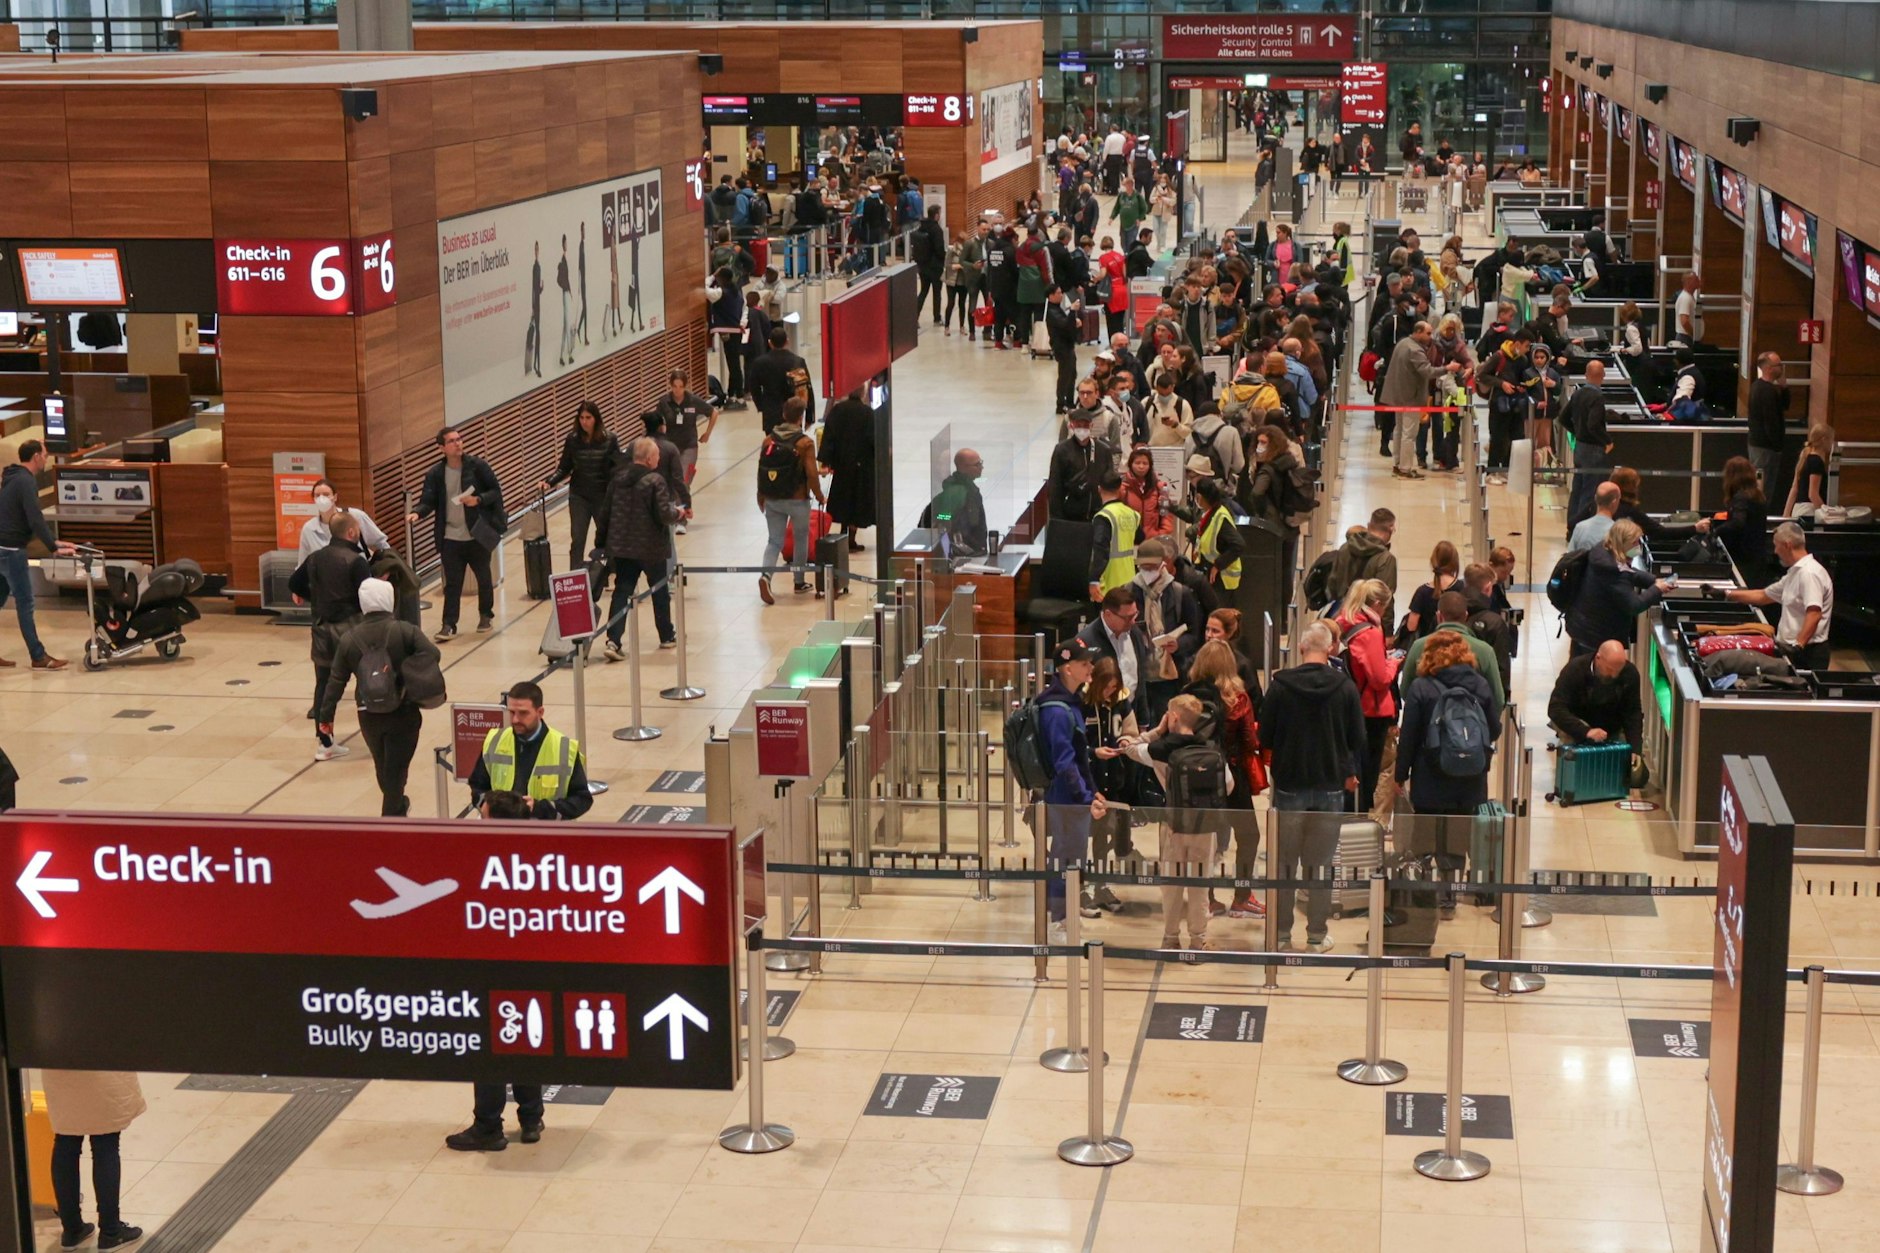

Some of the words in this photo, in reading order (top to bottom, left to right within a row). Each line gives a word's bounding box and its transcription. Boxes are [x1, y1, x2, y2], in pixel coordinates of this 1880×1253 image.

[1286, 25, 1293, 36] 5
[1222, 38, 1257, 49] Security
[1261, 38, 1293, 47] Control
[1217, 49, 1233, 57] Alle
[1235, 49, 1256, 57] Gates
[1260, 49, 1270, 57] All
[1271, 49, 1293, 57] Gates
[908, 96, 937, 104] Check-in
[943, 96, 961, 121] 8
[694, 162, 702, 200] 6
[442, 231, 471, 254] Business
[471, 231, 479, 247] as
[480, 221, 497, 244] usual
[226, 245, 291, 261] Check-in
[380, 239, 394, 293] 6
[443, 265, 455, 285] Der
[456, 259, 470, 281] BER
[471, 257, 480, 276] im
[480, 247, 510, 273] Überblick
[310, 246, 346, 300] 6
[564, 584, 585, 592] Runway
[469, 712, 484, 720] BER
[772, 709, 787, 717] BER
[469, 720, 500, 728] Runway
[772, 717, 804, 726] Runway
[93, 844, 272, 884] Check-in
[480, 853, 624, 903] Abflug
[965, 871, 981, 879] BER
[1138, 877, 1153, 885] BER
[1234, 880, 1250, 888] BER
[1332, 881, 1349, 889] BER
[1451, 883, 1468, 891] BER
[1550, 886, 1567, 894] BER
[465, 901, 626, 938] Departure
[825, 943, 841, 951] BER
[928, 946, 945, 955] BER
[1033, 947, 1049, 955] BER
[1179, 953, 1196, 961] BER
[1285, 957, 1303, 966] BER
[1392, 959, 1410, 967] BER
[1531, 965, 1549, 973] BER
[1640, 968, 1658, 977] BER
[301, 987, 481, 1023] Großgepäck
[1197, 1005, 1220, 1030] Runway
[1180, 1017, 1196, 1029] BER
[1680, 1022, 1698, 1047] Runway
[308, 1024, 373, 1052] Bulky
[380, 1027, 482, 1056] Baggage
[1663, 1034, 1681, 1046] BER
[944, 1087, 963, 1102] BER
[916, 1087, 945, 1116] Runway
[1461, 1107, 1478, 1121] BER
